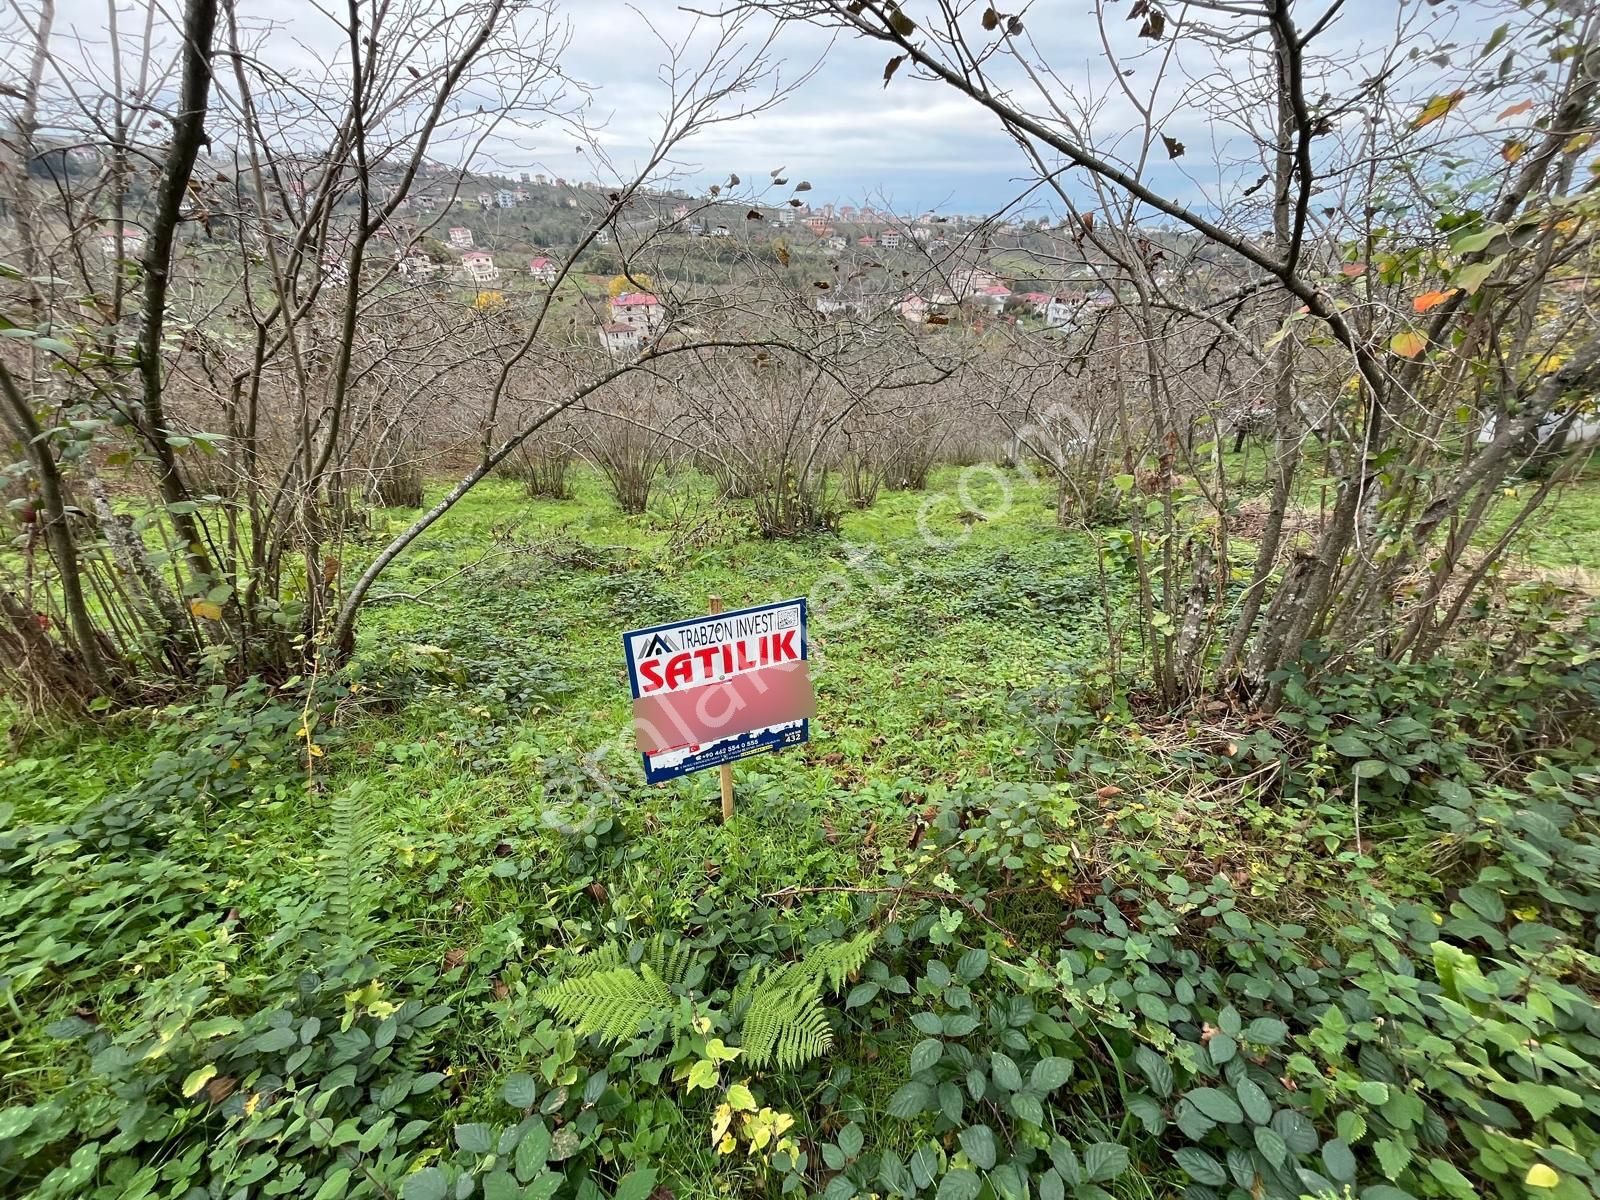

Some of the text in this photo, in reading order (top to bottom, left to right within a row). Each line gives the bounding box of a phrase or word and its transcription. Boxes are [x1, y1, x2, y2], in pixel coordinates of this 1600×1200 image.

[678, 612, 775, 650] TRABZON INVEST
[639, 630, 798, 692] SATILIK
[785, 733, 801, 743] 432
[714, 748, 726, 756] 462
[727, 745, 740, 753] 554
